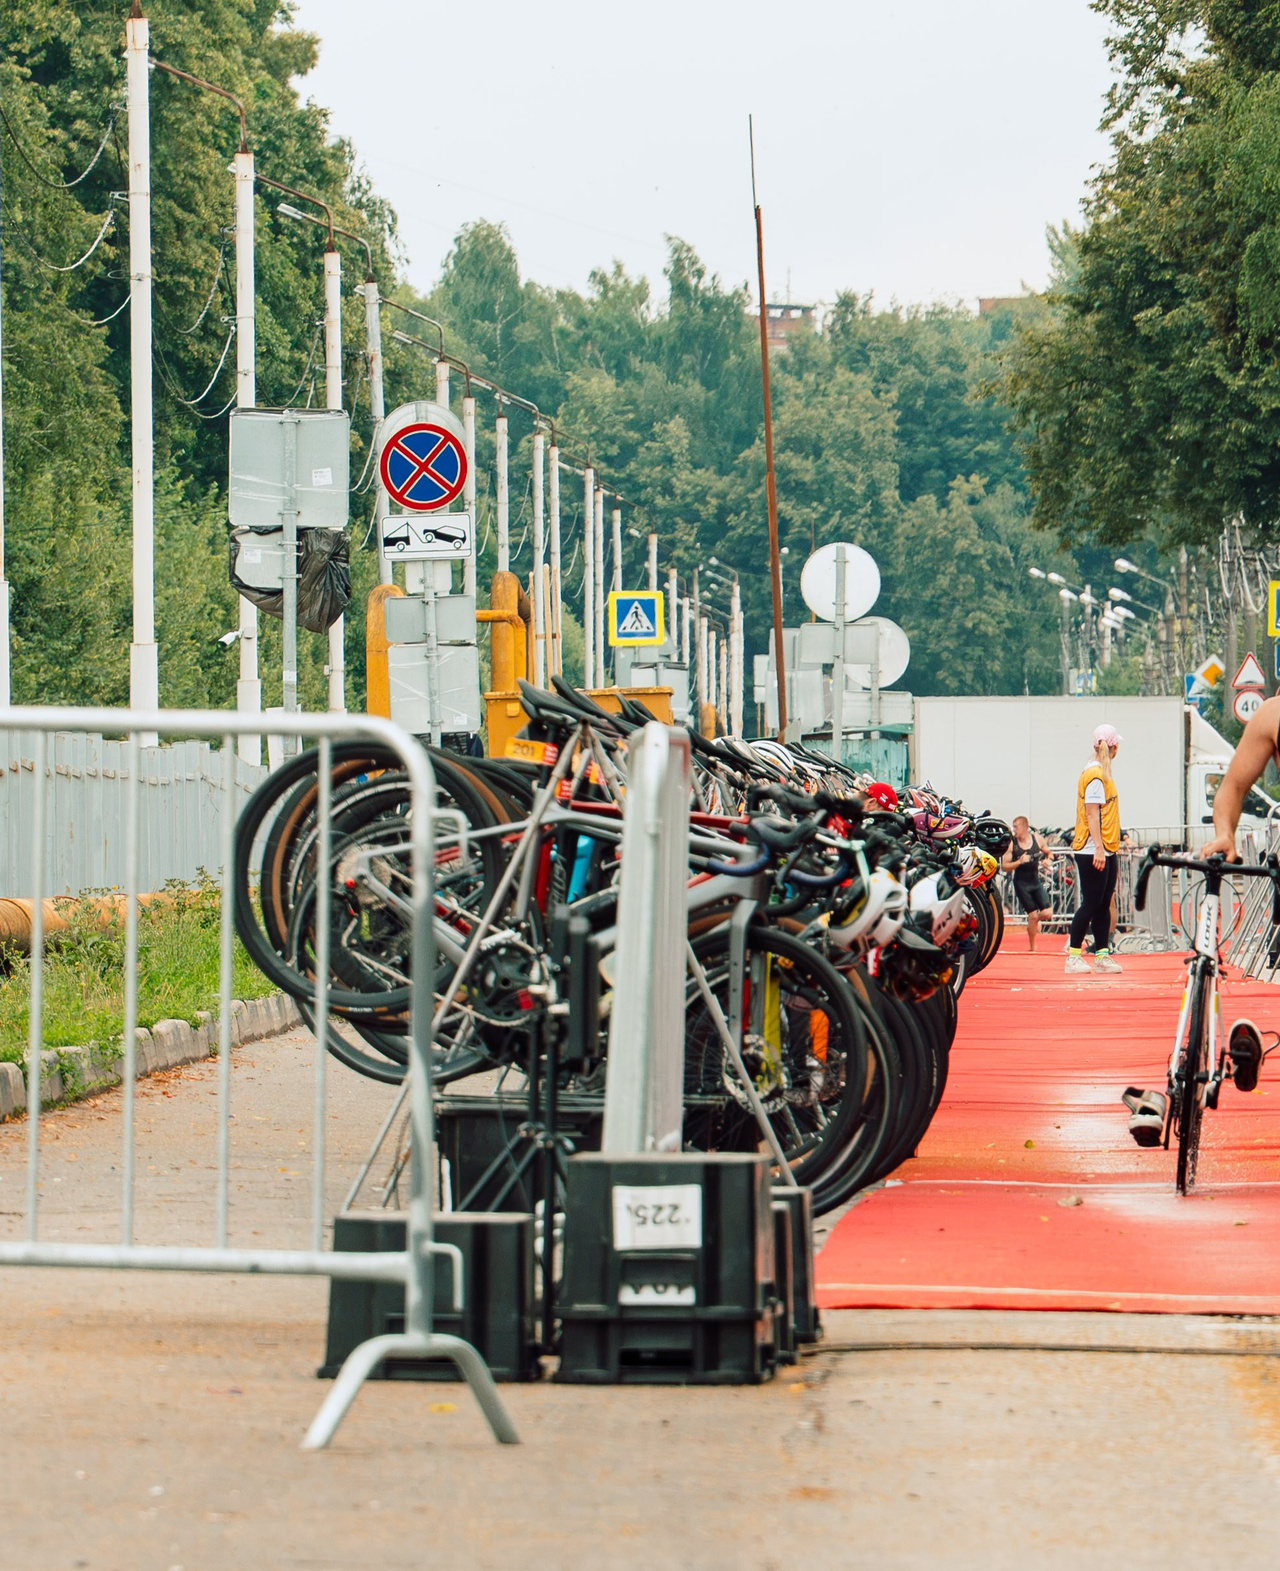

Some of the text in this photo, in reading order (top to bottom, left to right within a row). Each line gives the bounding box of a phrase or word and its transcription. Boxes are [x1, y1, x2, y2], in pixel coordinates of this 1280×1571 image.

[1241, 700, 1260, 712] 40
[512, 743, 536, 757] 201
[1204, 903, 1213, 949] LOOK
